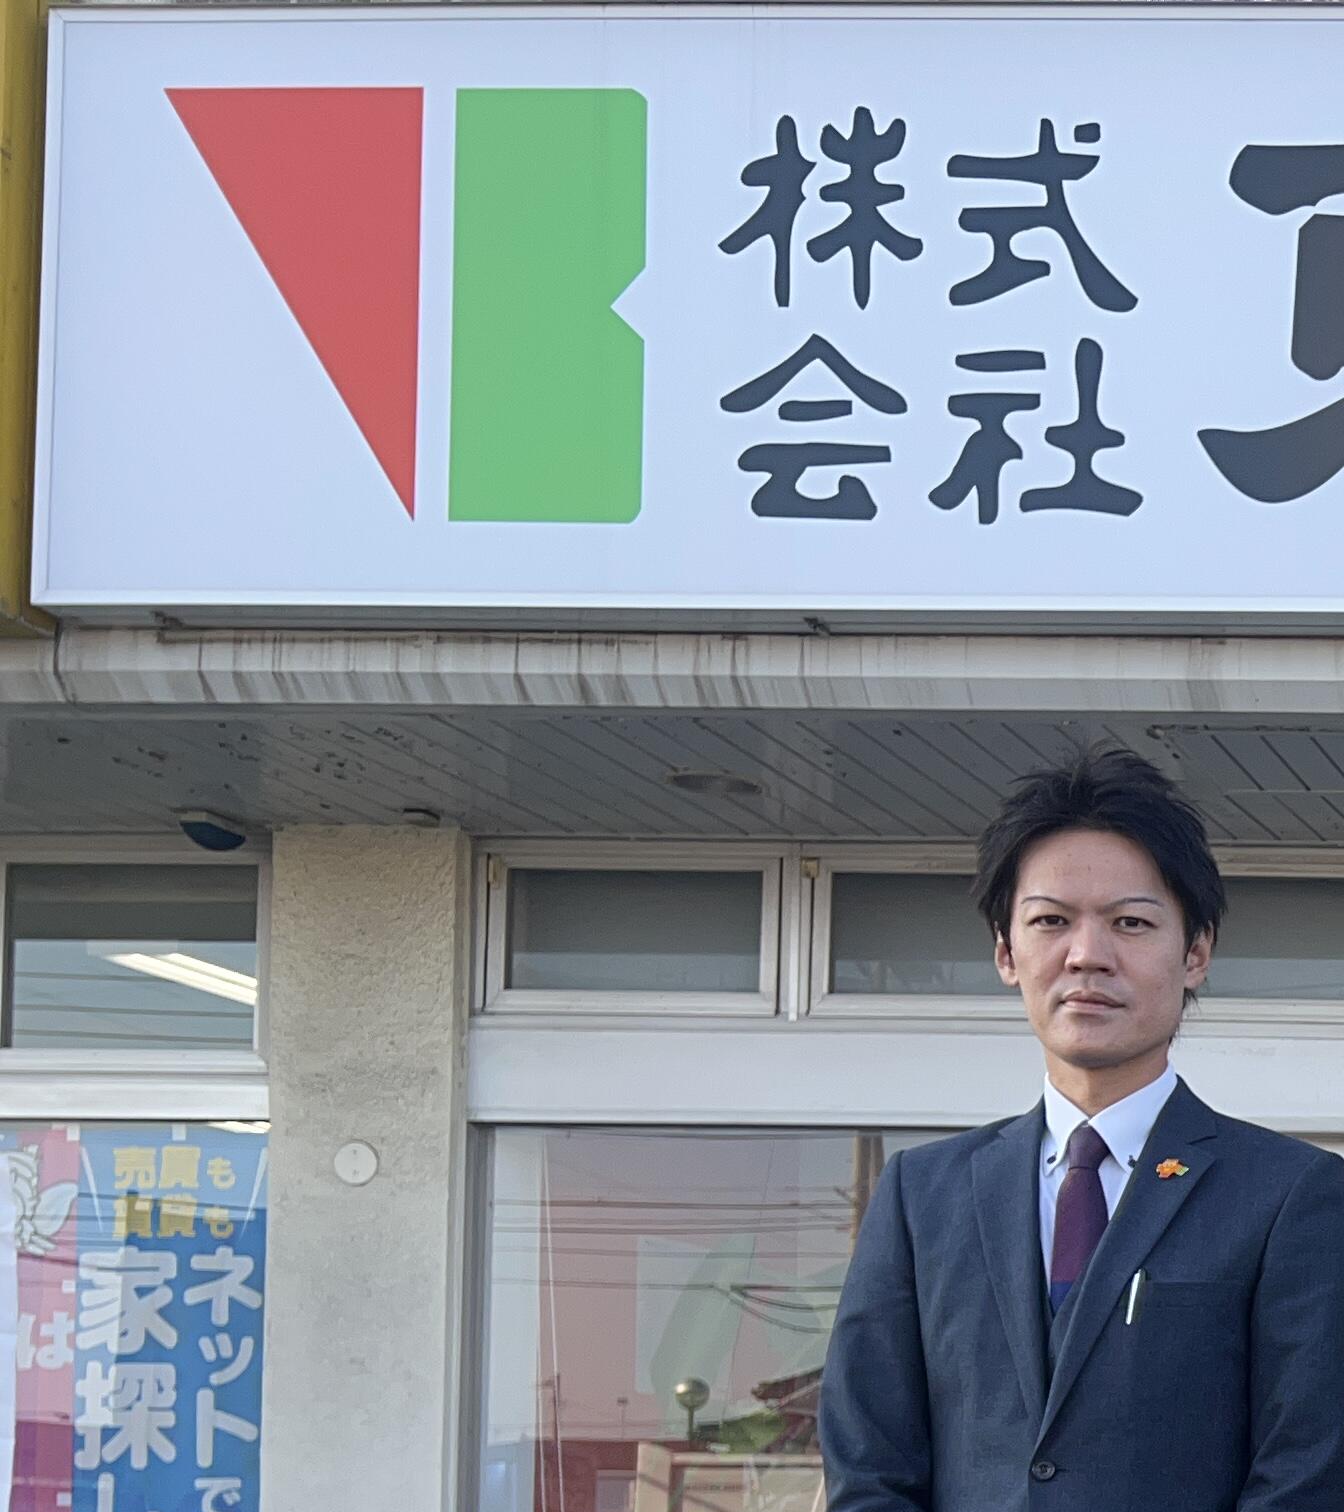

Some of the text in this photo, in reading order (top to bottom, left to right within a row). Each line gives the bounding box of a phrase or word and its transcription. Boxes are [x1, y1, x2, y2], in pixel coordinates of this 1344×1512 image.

[113, 1146, 236, 1190] 売買も
[112, 1193, 236, 1240] 賃貸も
